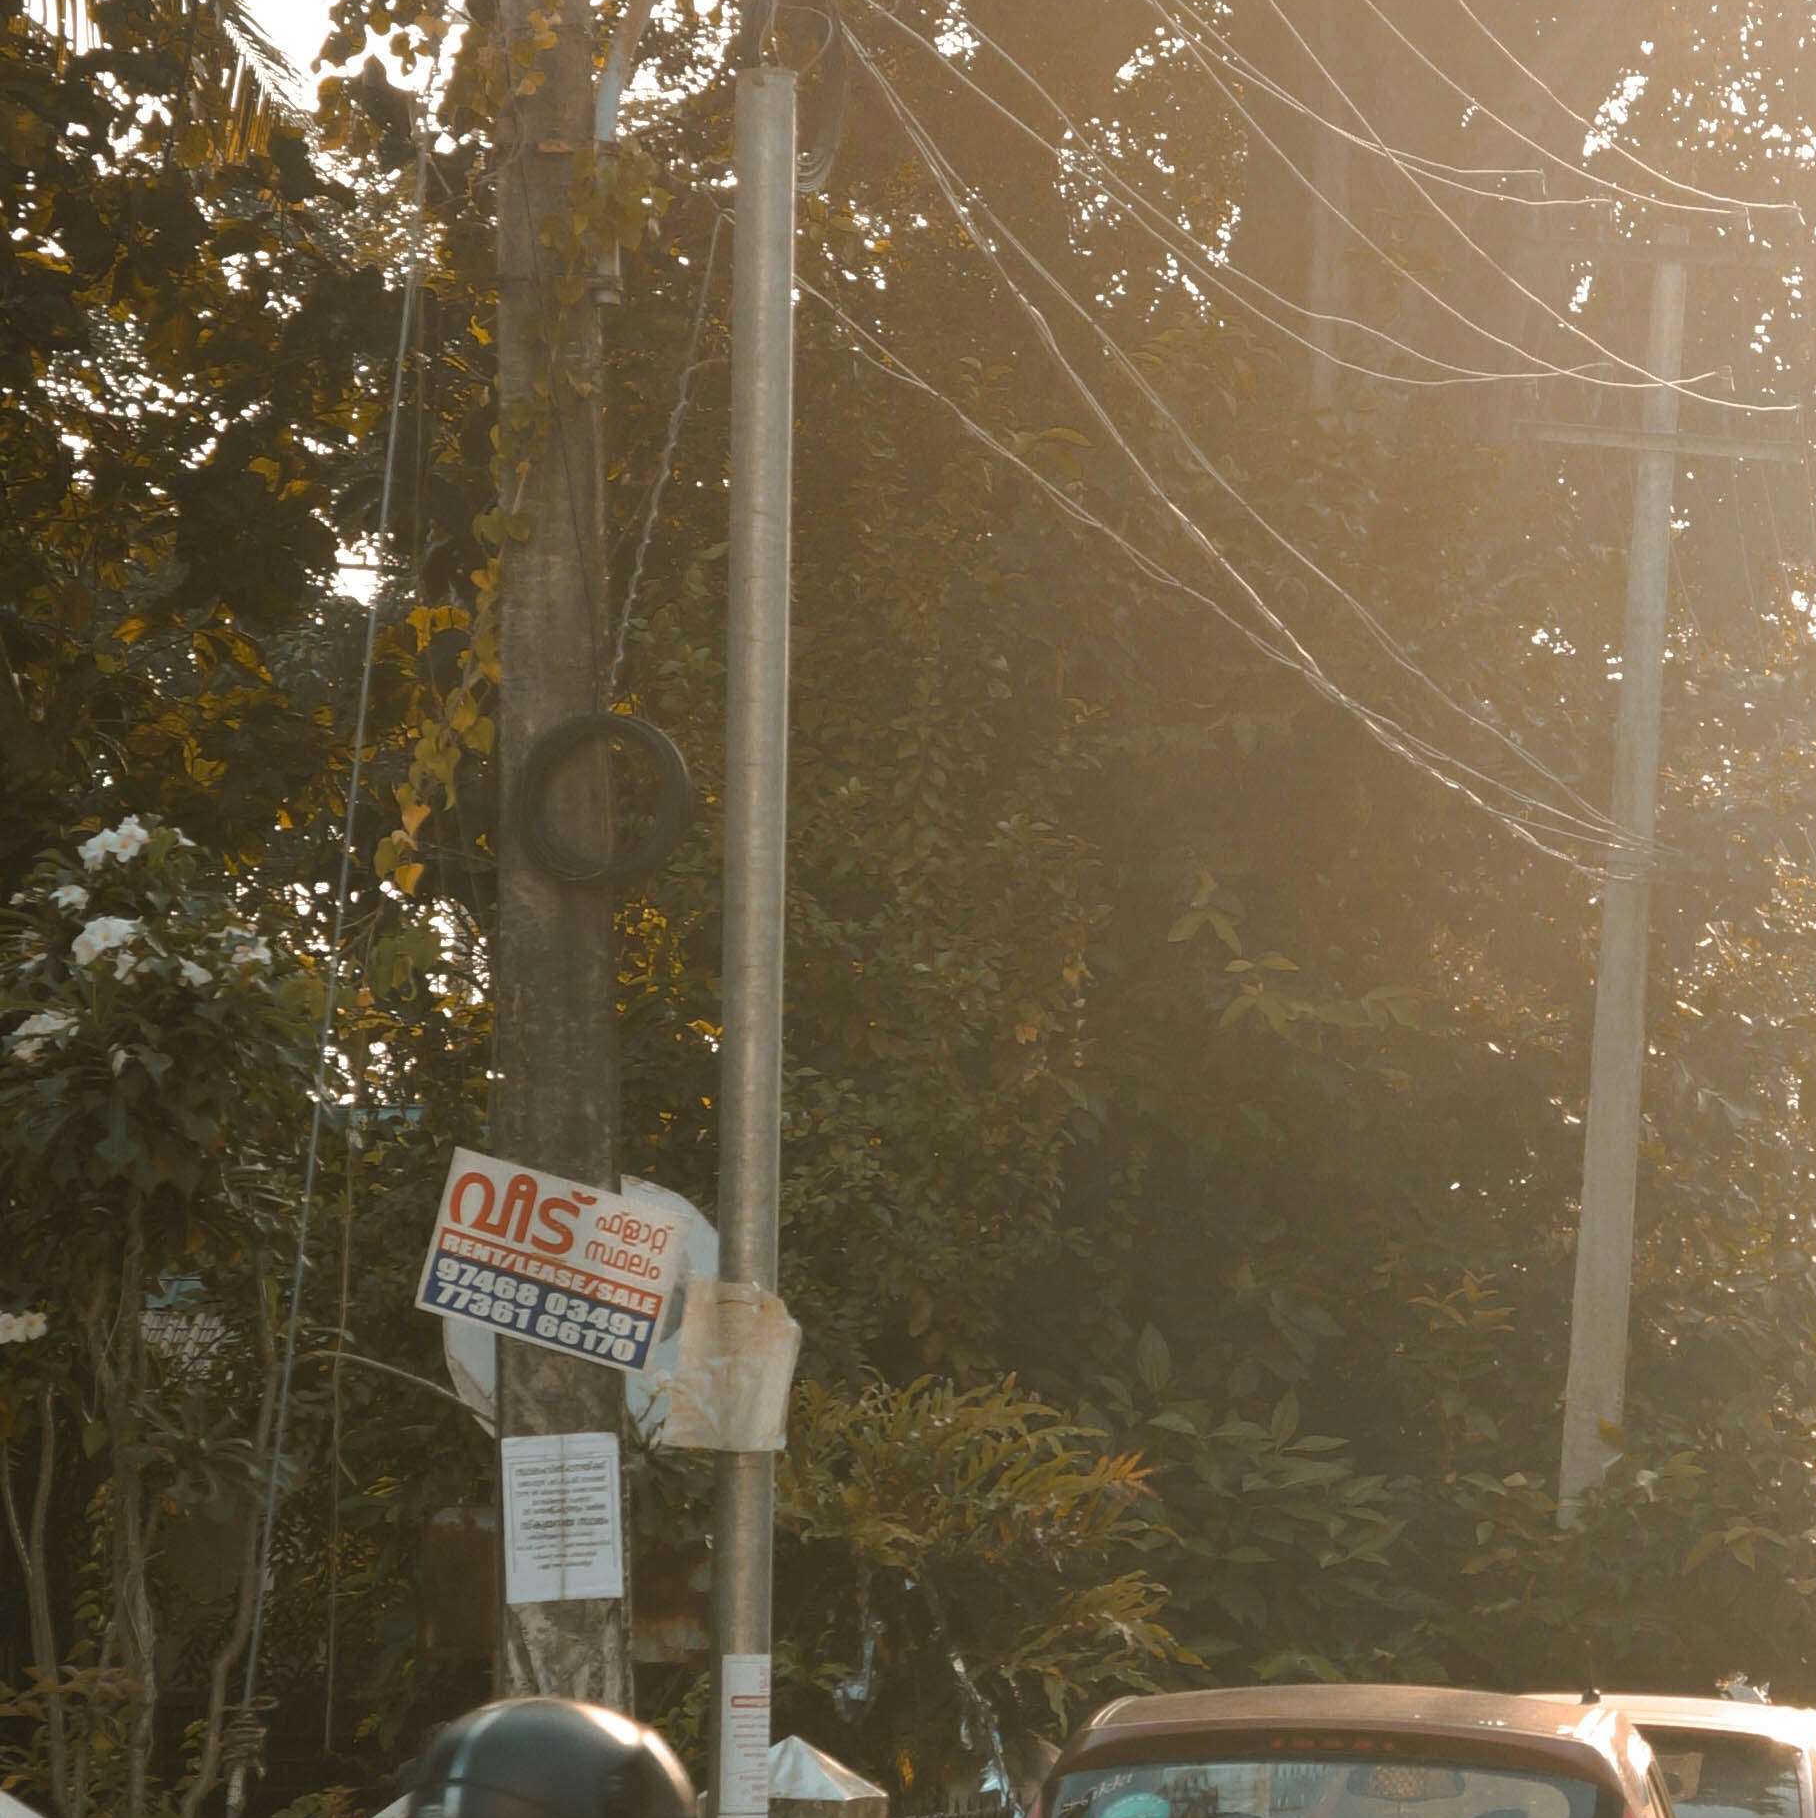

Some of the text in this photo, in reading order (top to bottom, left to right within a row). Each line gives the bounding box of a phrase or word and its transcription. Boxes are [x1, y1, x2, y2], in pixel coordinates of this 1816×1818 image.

[450, 1172, 597, 1255] വീട്
[435, 1257, 649, 1342] 97468 03491
[441, 1232, 657, 1314] RENT/LEASE/SALE
[585, 1239, 661, 1280] സ്ഥലം
[435, 1281, 636, 1362] 77361 66170
